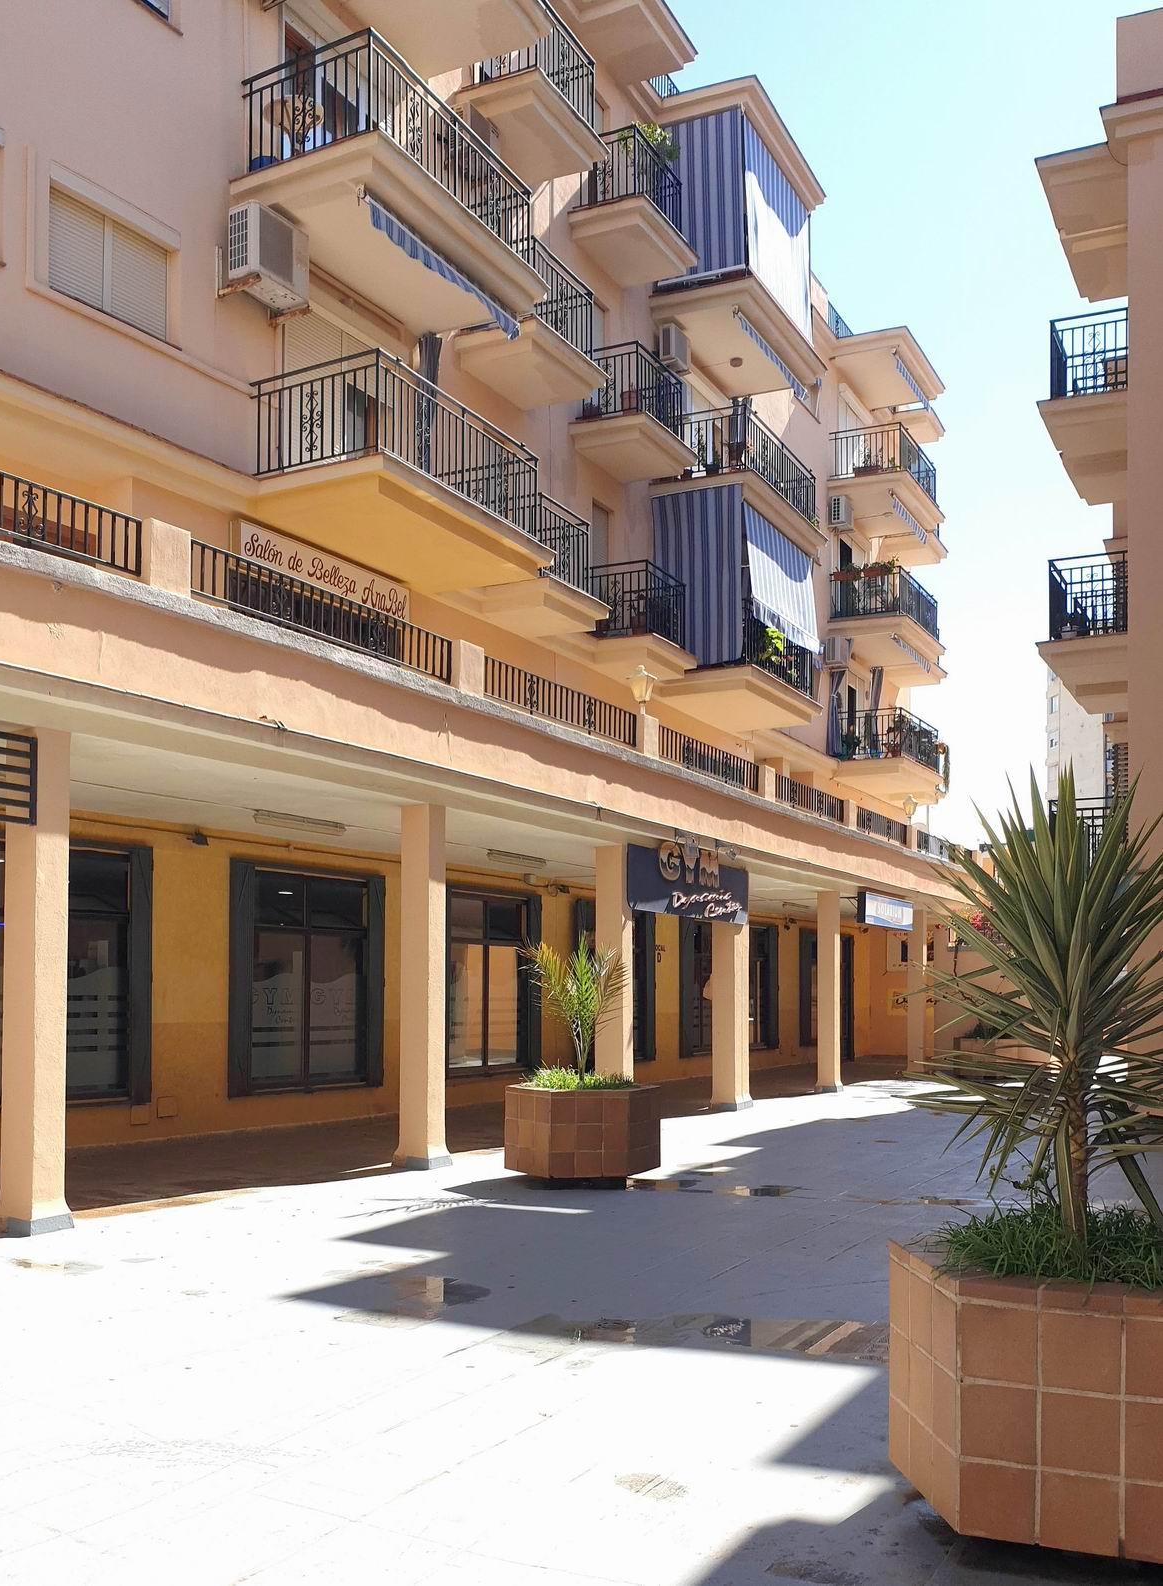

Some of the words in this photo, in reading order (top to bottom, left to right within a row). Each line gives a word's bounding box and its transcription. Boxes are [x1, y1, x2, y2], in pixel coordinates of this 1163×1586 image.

[244, 533, 284, 567] Salón
[287, 550, 303, 573] de
[307, 557, 357, 597] Belleza
[659, 841, 720, 889] GYM
